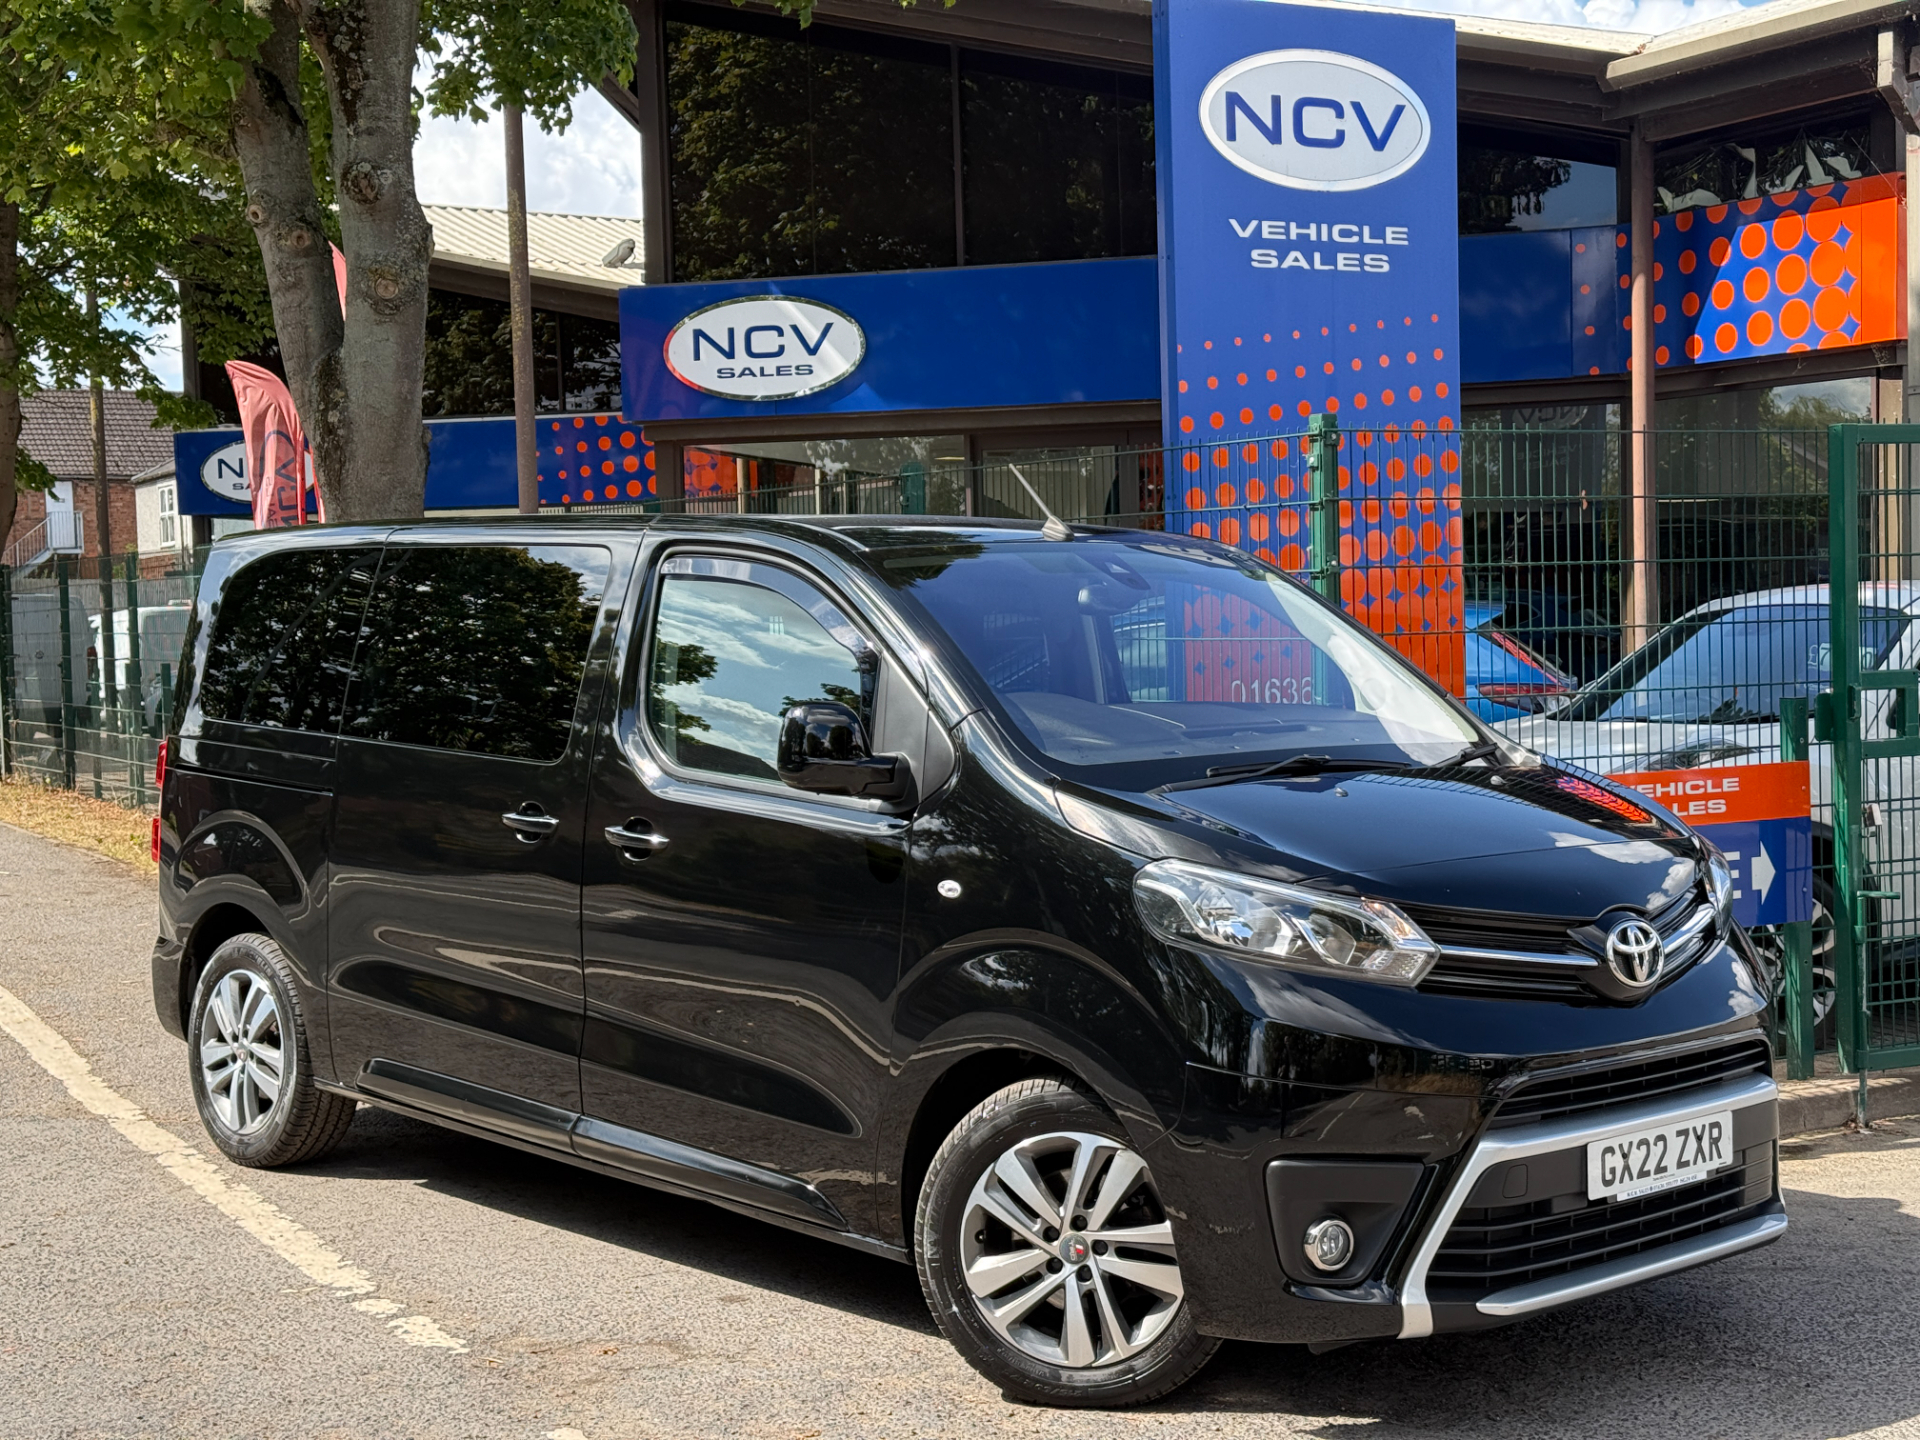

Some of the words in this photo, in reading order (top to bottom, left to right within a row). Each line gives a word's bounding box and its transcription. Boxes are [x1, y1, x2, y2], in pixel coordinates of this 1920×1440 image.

[1225, 91, 1406, 152] NCV
[1228, 218, 1409, 245] VEHICLE
[1251, 249, 1390, 273] SALES
[692, 322, 834, 361] NCV
[716, 364, 814, 379] SALES
[1631, 777, 1740, 798] EHICLE
[1601, 1133, 1668, 1187] GX22
[1676, 1121, 1722, 1169] ZXR
